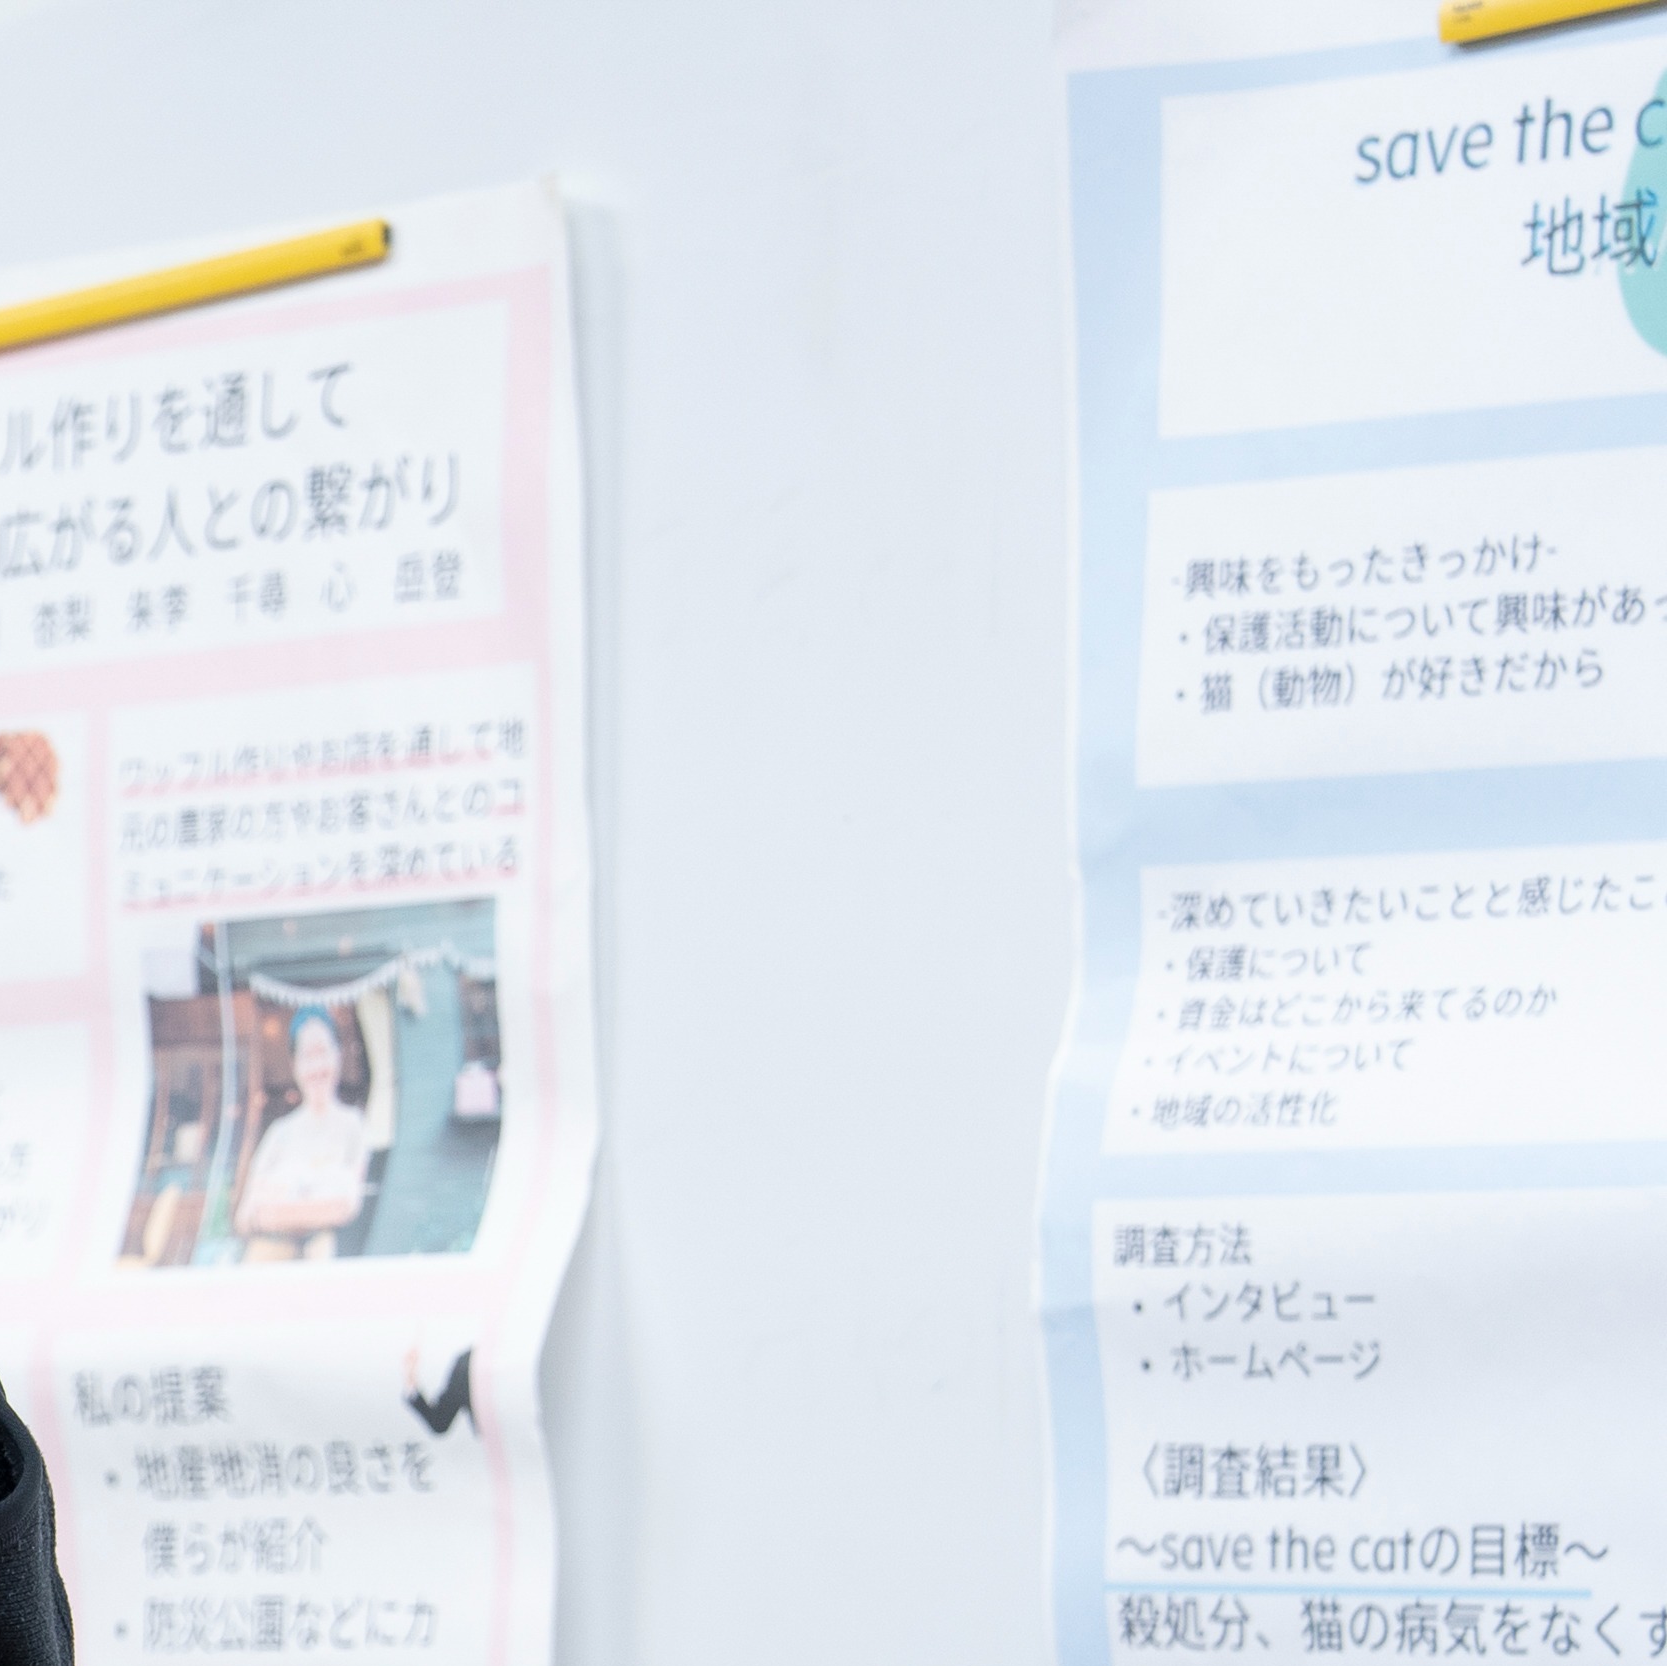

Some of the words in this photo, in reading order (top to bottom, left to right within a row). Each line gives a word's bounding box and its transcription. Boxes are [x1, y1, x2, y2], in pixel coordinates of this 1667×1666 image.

[1356, 121, 1493, 184] save
[1515, 95, 1614, 165] the
[1521, 187, 1657, 277] 地域
[1158, 874, 1667, 932] -深めていきたいことと感じたこ
[1185, 940, 1371, 983] 保護について
[1177, 984, 1558, 1032] 資金はどこから来てるのか
[1166, 1037, 1416, 1077] イベントについて
[1151, 1089, 1339, 1130] 地域の活性化
[1113, 1221, 1252, 1268] 調査方法
[1164, 1278, 1376, 1322] インタビュー
[1169, 1340, 1382, 1381] ホームページ
[73, 1364, 229, 1425] 私の提案
[134, 1439, 435, 1499] 地産地消の良さを
[142, 1515, 327, 1576] 僕らが紹介
[1269, 1525, 1337, 1572] the
